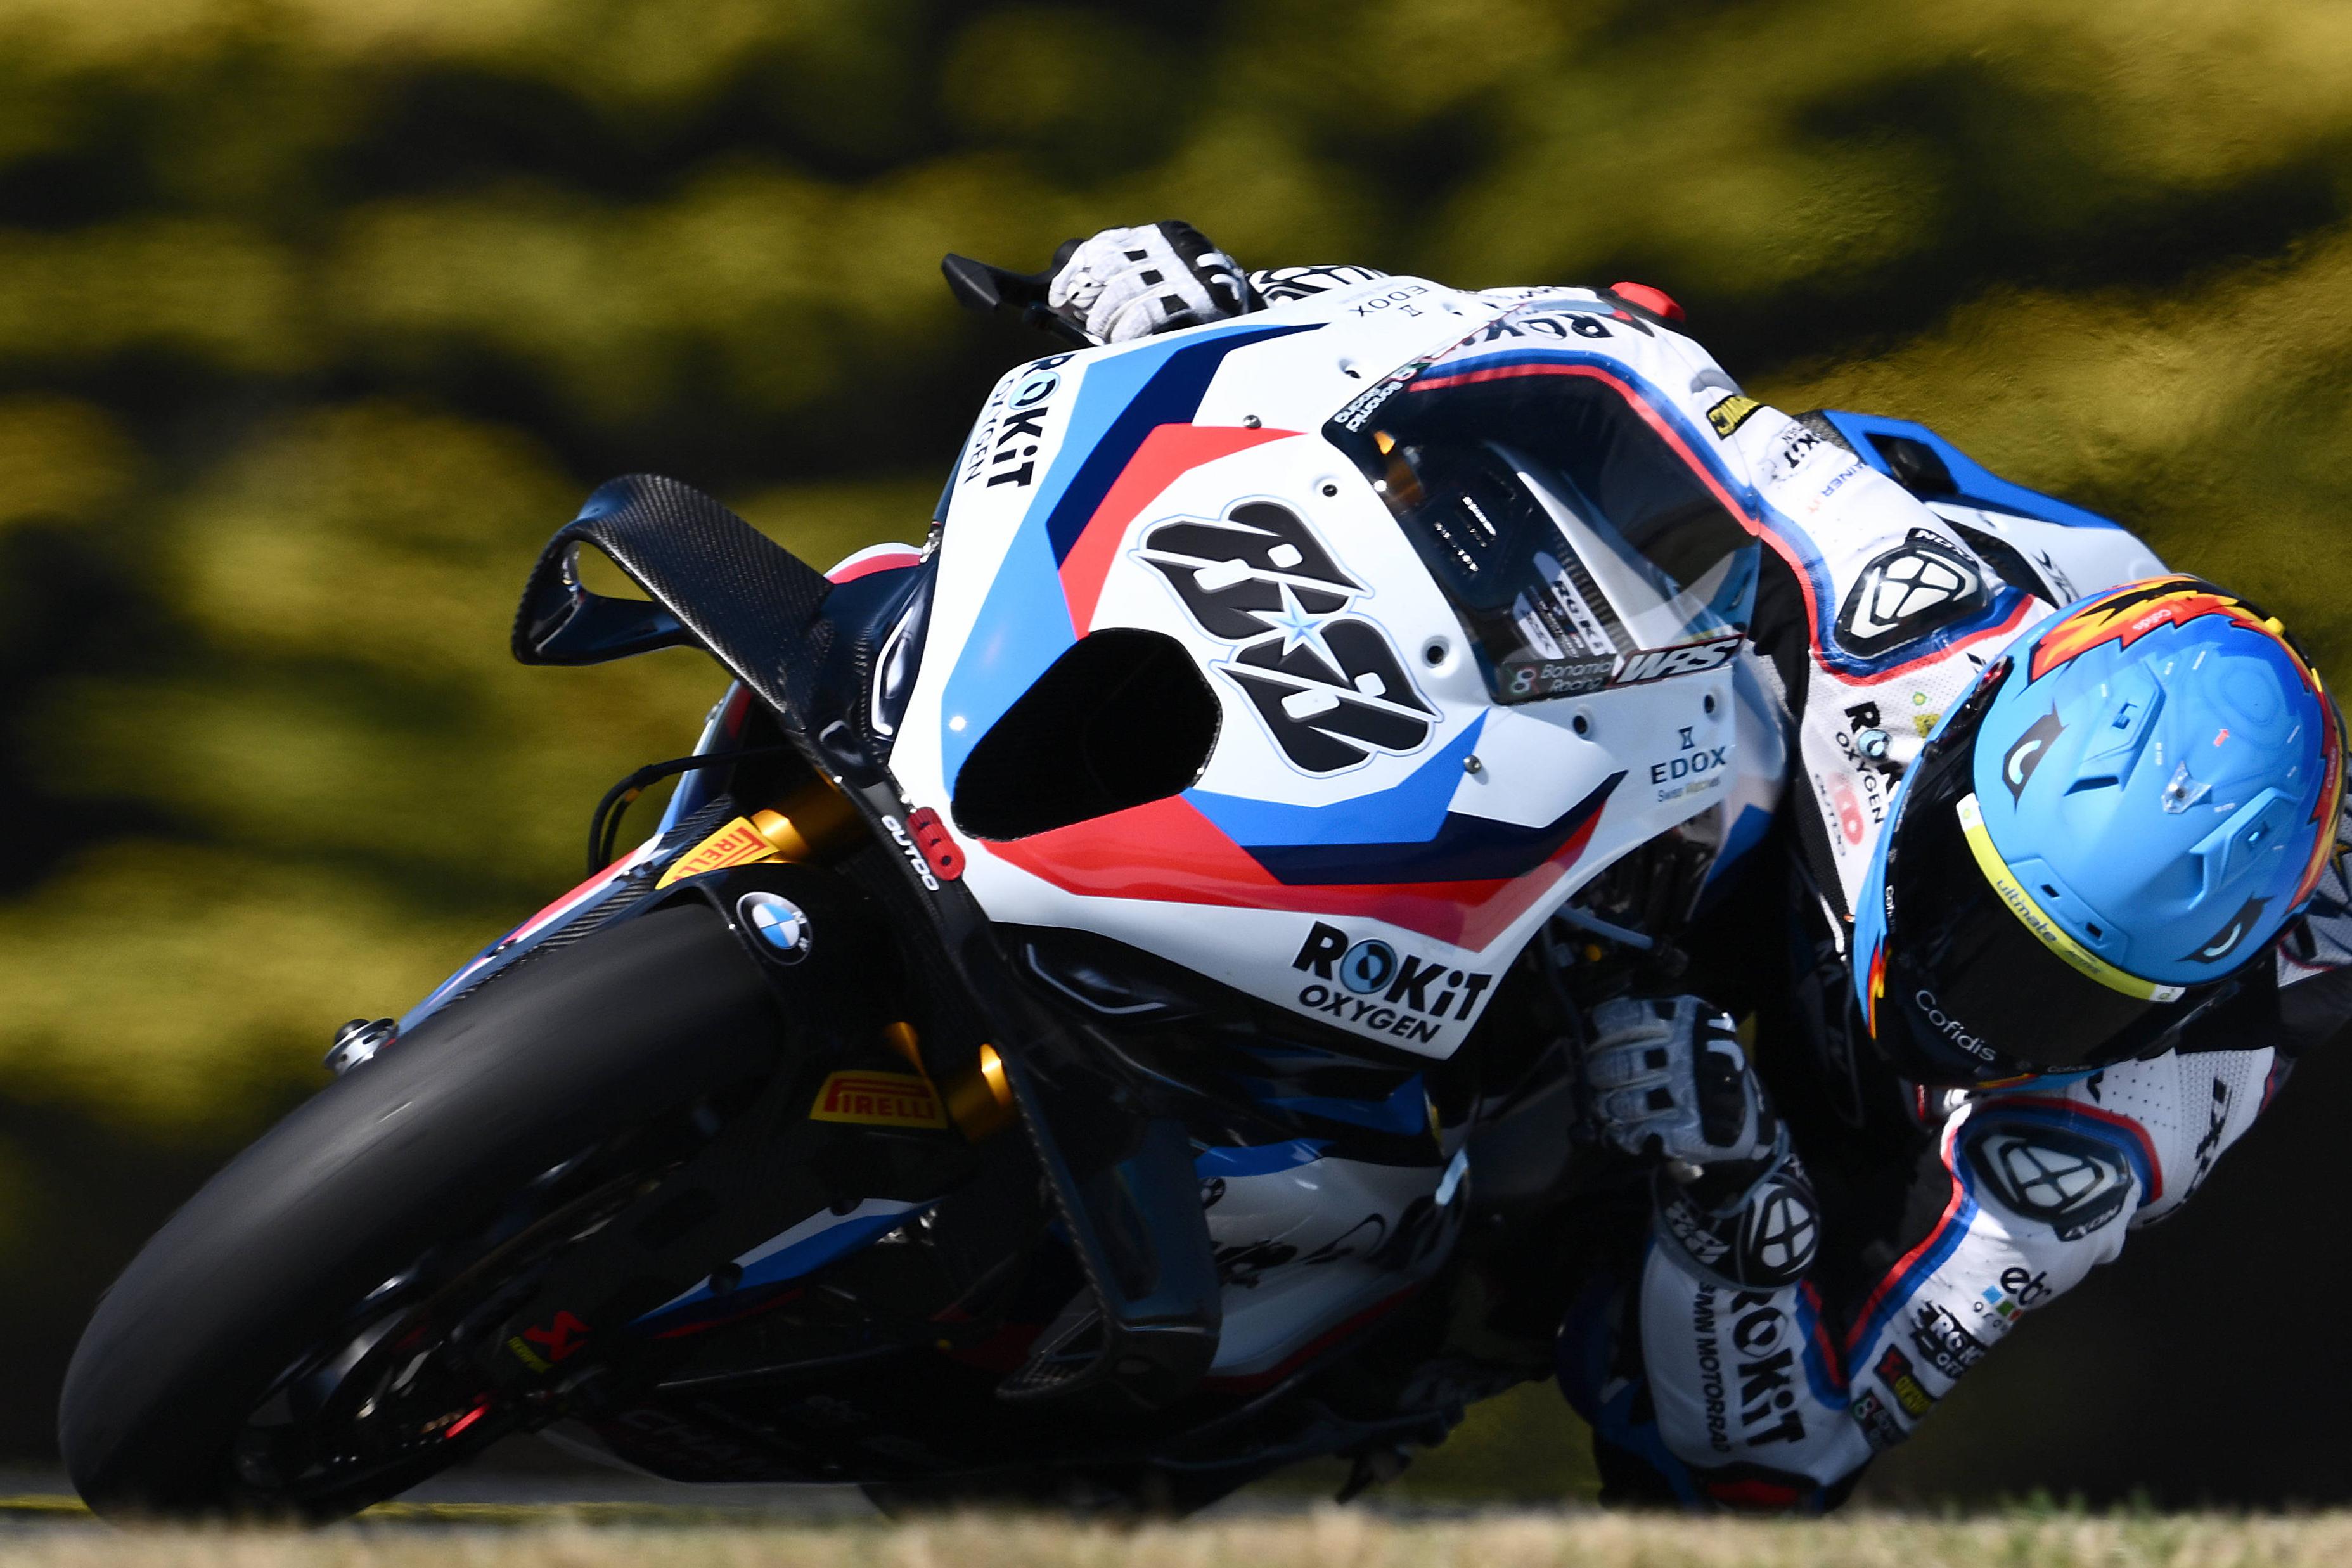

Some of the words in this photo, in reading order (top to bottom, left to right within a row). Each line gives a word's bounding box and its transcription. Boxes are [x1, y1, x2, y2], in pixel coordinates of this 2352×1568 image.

[1349, 285, 1429, 316] EDOX
[2131, 608, 2172, 631] Cofidis
[1616, 639, 1742, 684] WRS
[1650, 746, 1726, 785] EDOX
[1835, 731, 1884, 824] OXYGEN
[881, 815, 939, 891] OUTDO
[1997, 880, 2057, 942] ultimate
[1292, 920, 1493, 1021] ROKiT
[1298, 984, 1442, 1044] OXYGEN
[1915, 989, 1997, 1062] Cofidis
[823, 1078, 935, 1120] PIRELLI
[1697, 1337, 1731, 1453] MOTORRAD
